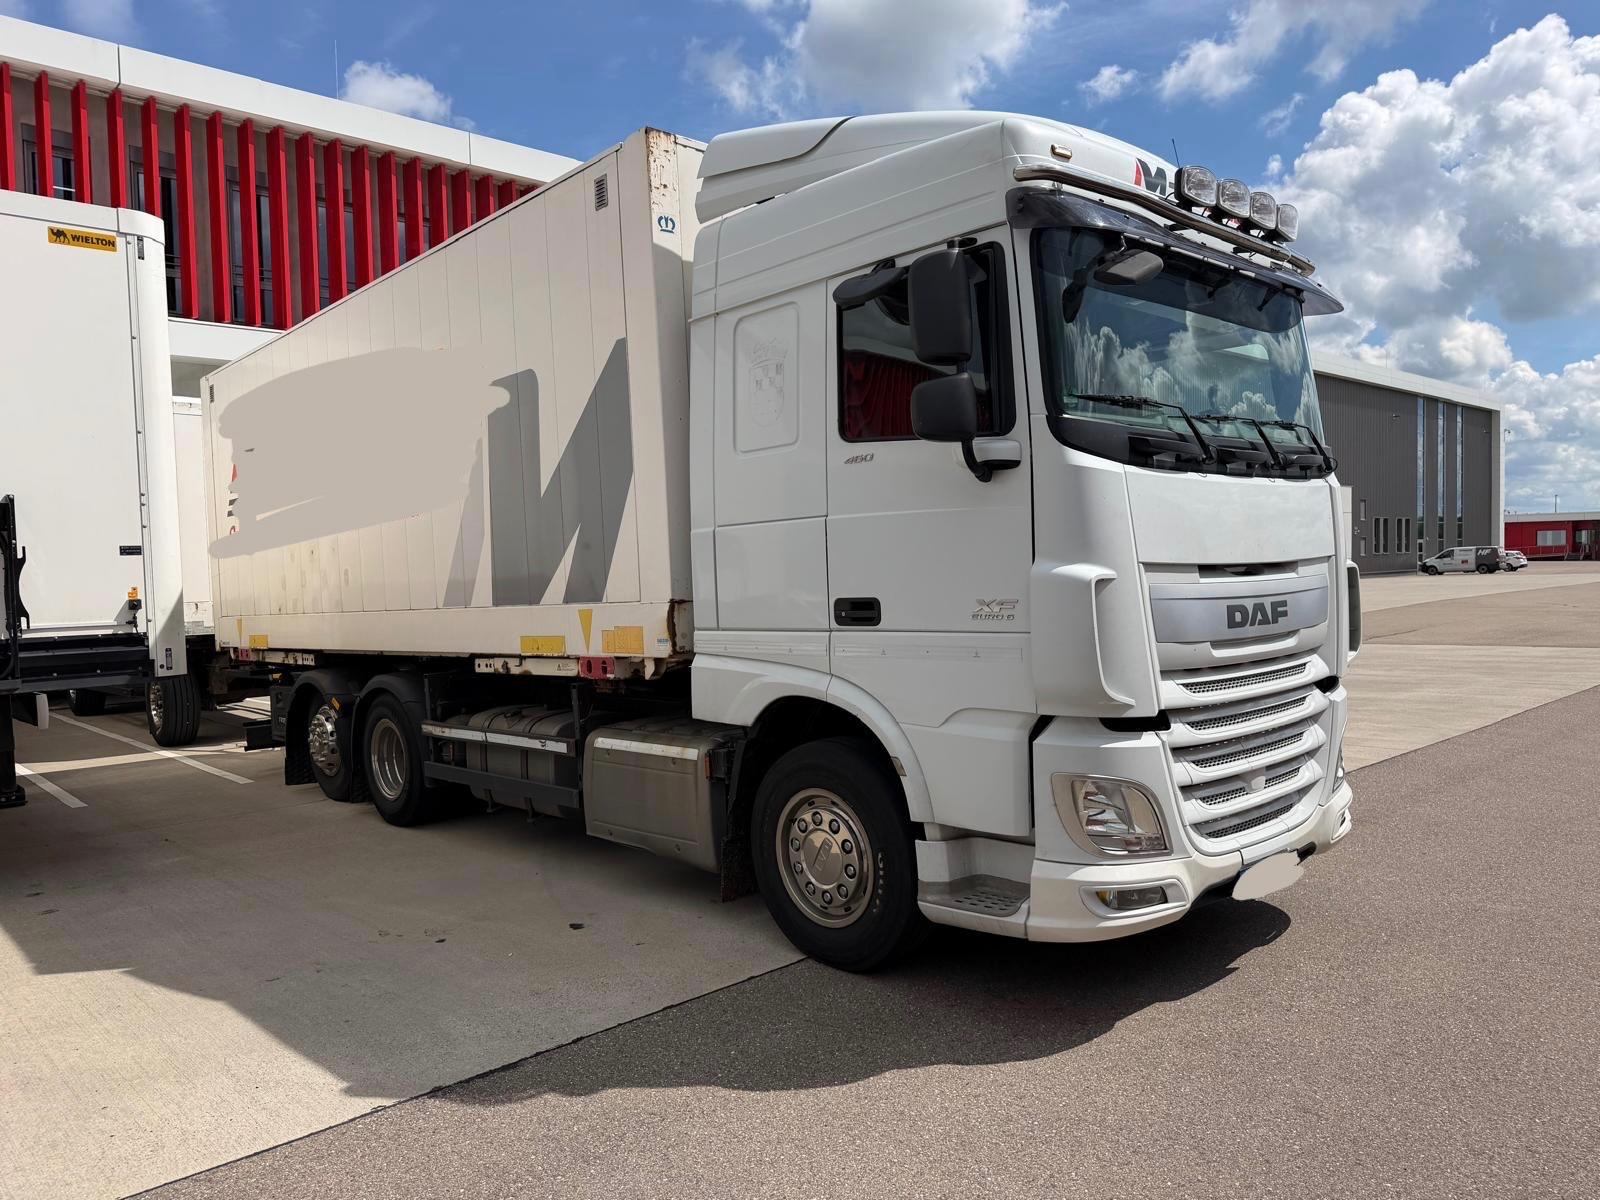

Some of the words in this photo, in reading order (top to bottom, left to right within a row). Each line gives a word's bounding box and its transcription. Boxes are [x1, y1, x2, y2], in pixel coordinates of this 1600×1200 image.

[70, 233, 116, 248] WIELTON
[843, 452, 874, 465] 460
[974, 598, 1019, 613] XF
[1226, 599, 1289, 629] DAF
